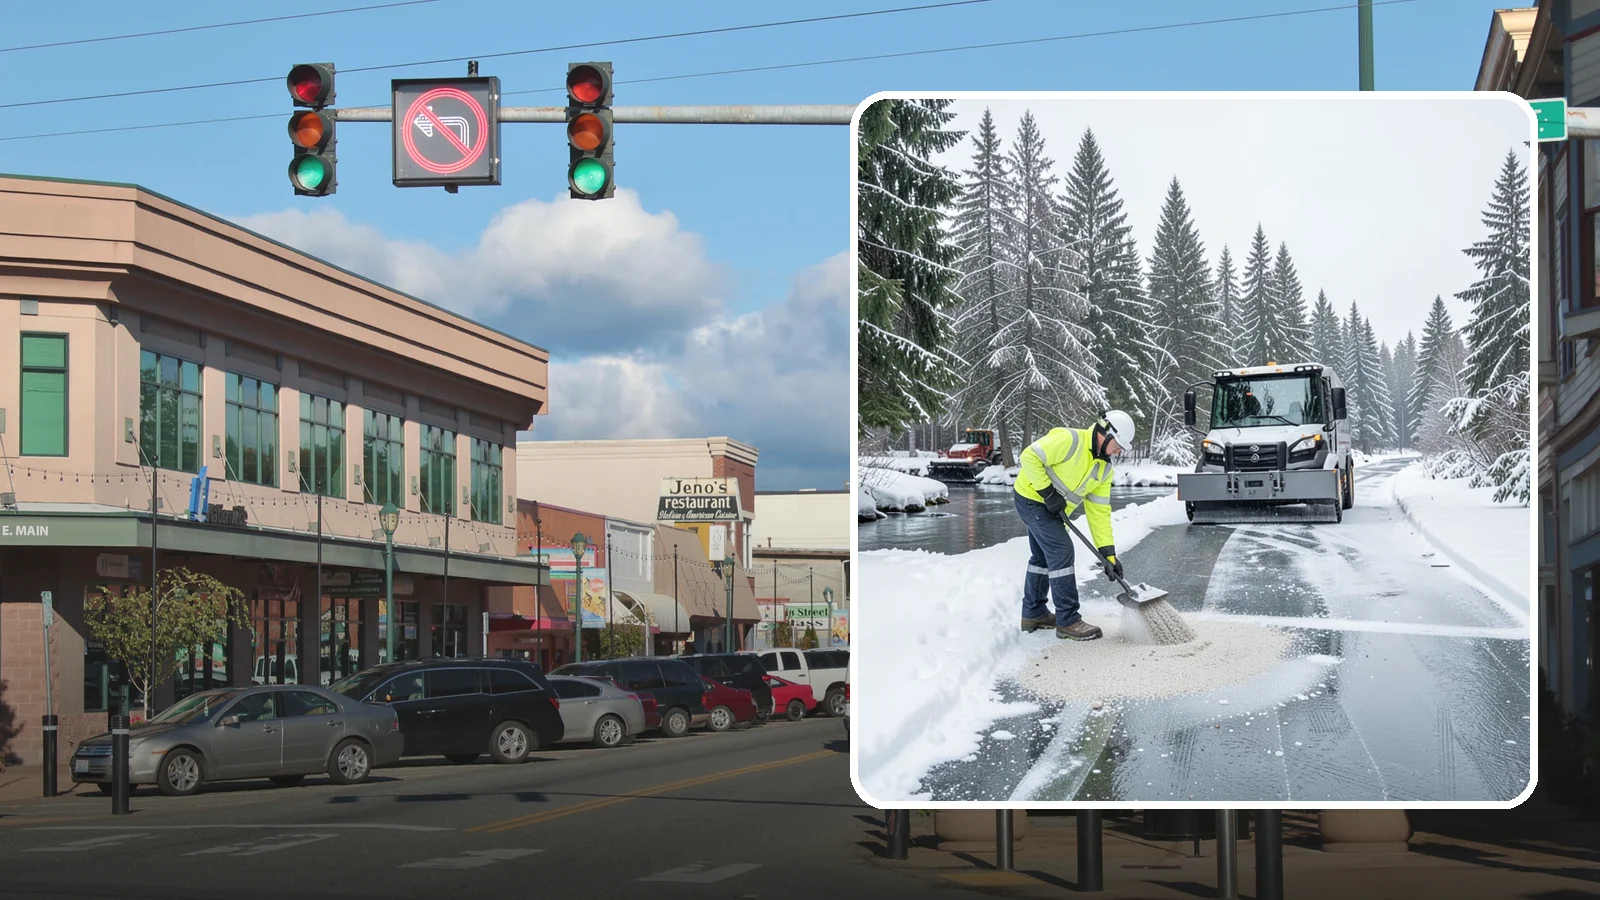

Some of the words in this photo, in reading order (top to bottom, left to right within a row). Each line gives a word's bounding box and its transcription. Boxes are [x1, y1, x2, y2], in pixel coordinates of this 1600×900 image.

[669, 480, 728, 494] Jeno's
[665, 496, 731, 509] restaurant
[658, 510, 682, 519] Italian
[686, 510, 714, 519] American
[715, 510, 737, 519] Cuisine
[2, 525, 13, 536] E.
[15, 525, 49, 536] MAIN
[797, 607, 828, 616] Street
